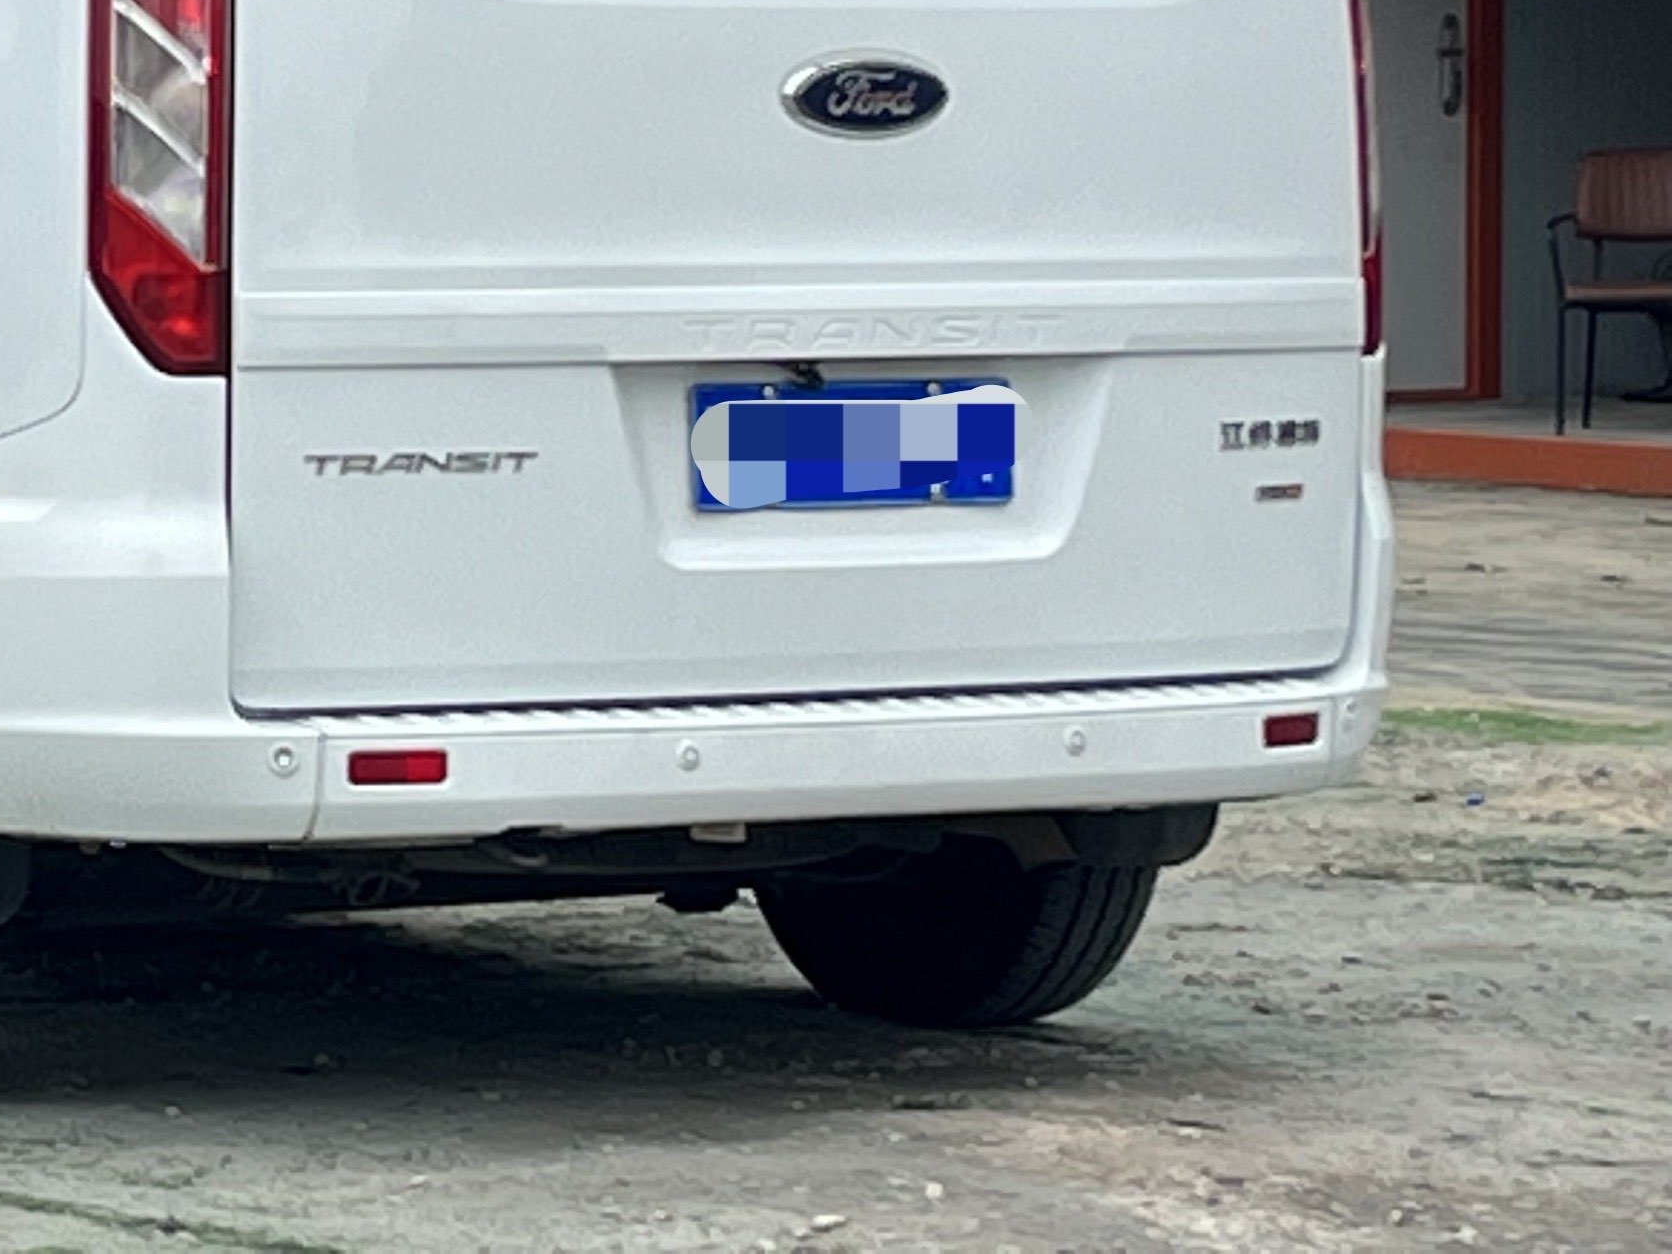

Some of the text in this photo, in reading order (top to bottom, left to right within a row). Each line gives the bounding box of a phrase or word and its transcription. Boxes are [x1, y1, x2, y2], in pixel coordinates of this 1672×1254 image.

[827, 69, 918, 117] Ford
[683, 313, 1067, 352] TRANSIT
[303, 451, 539, 476] TRANSIT
